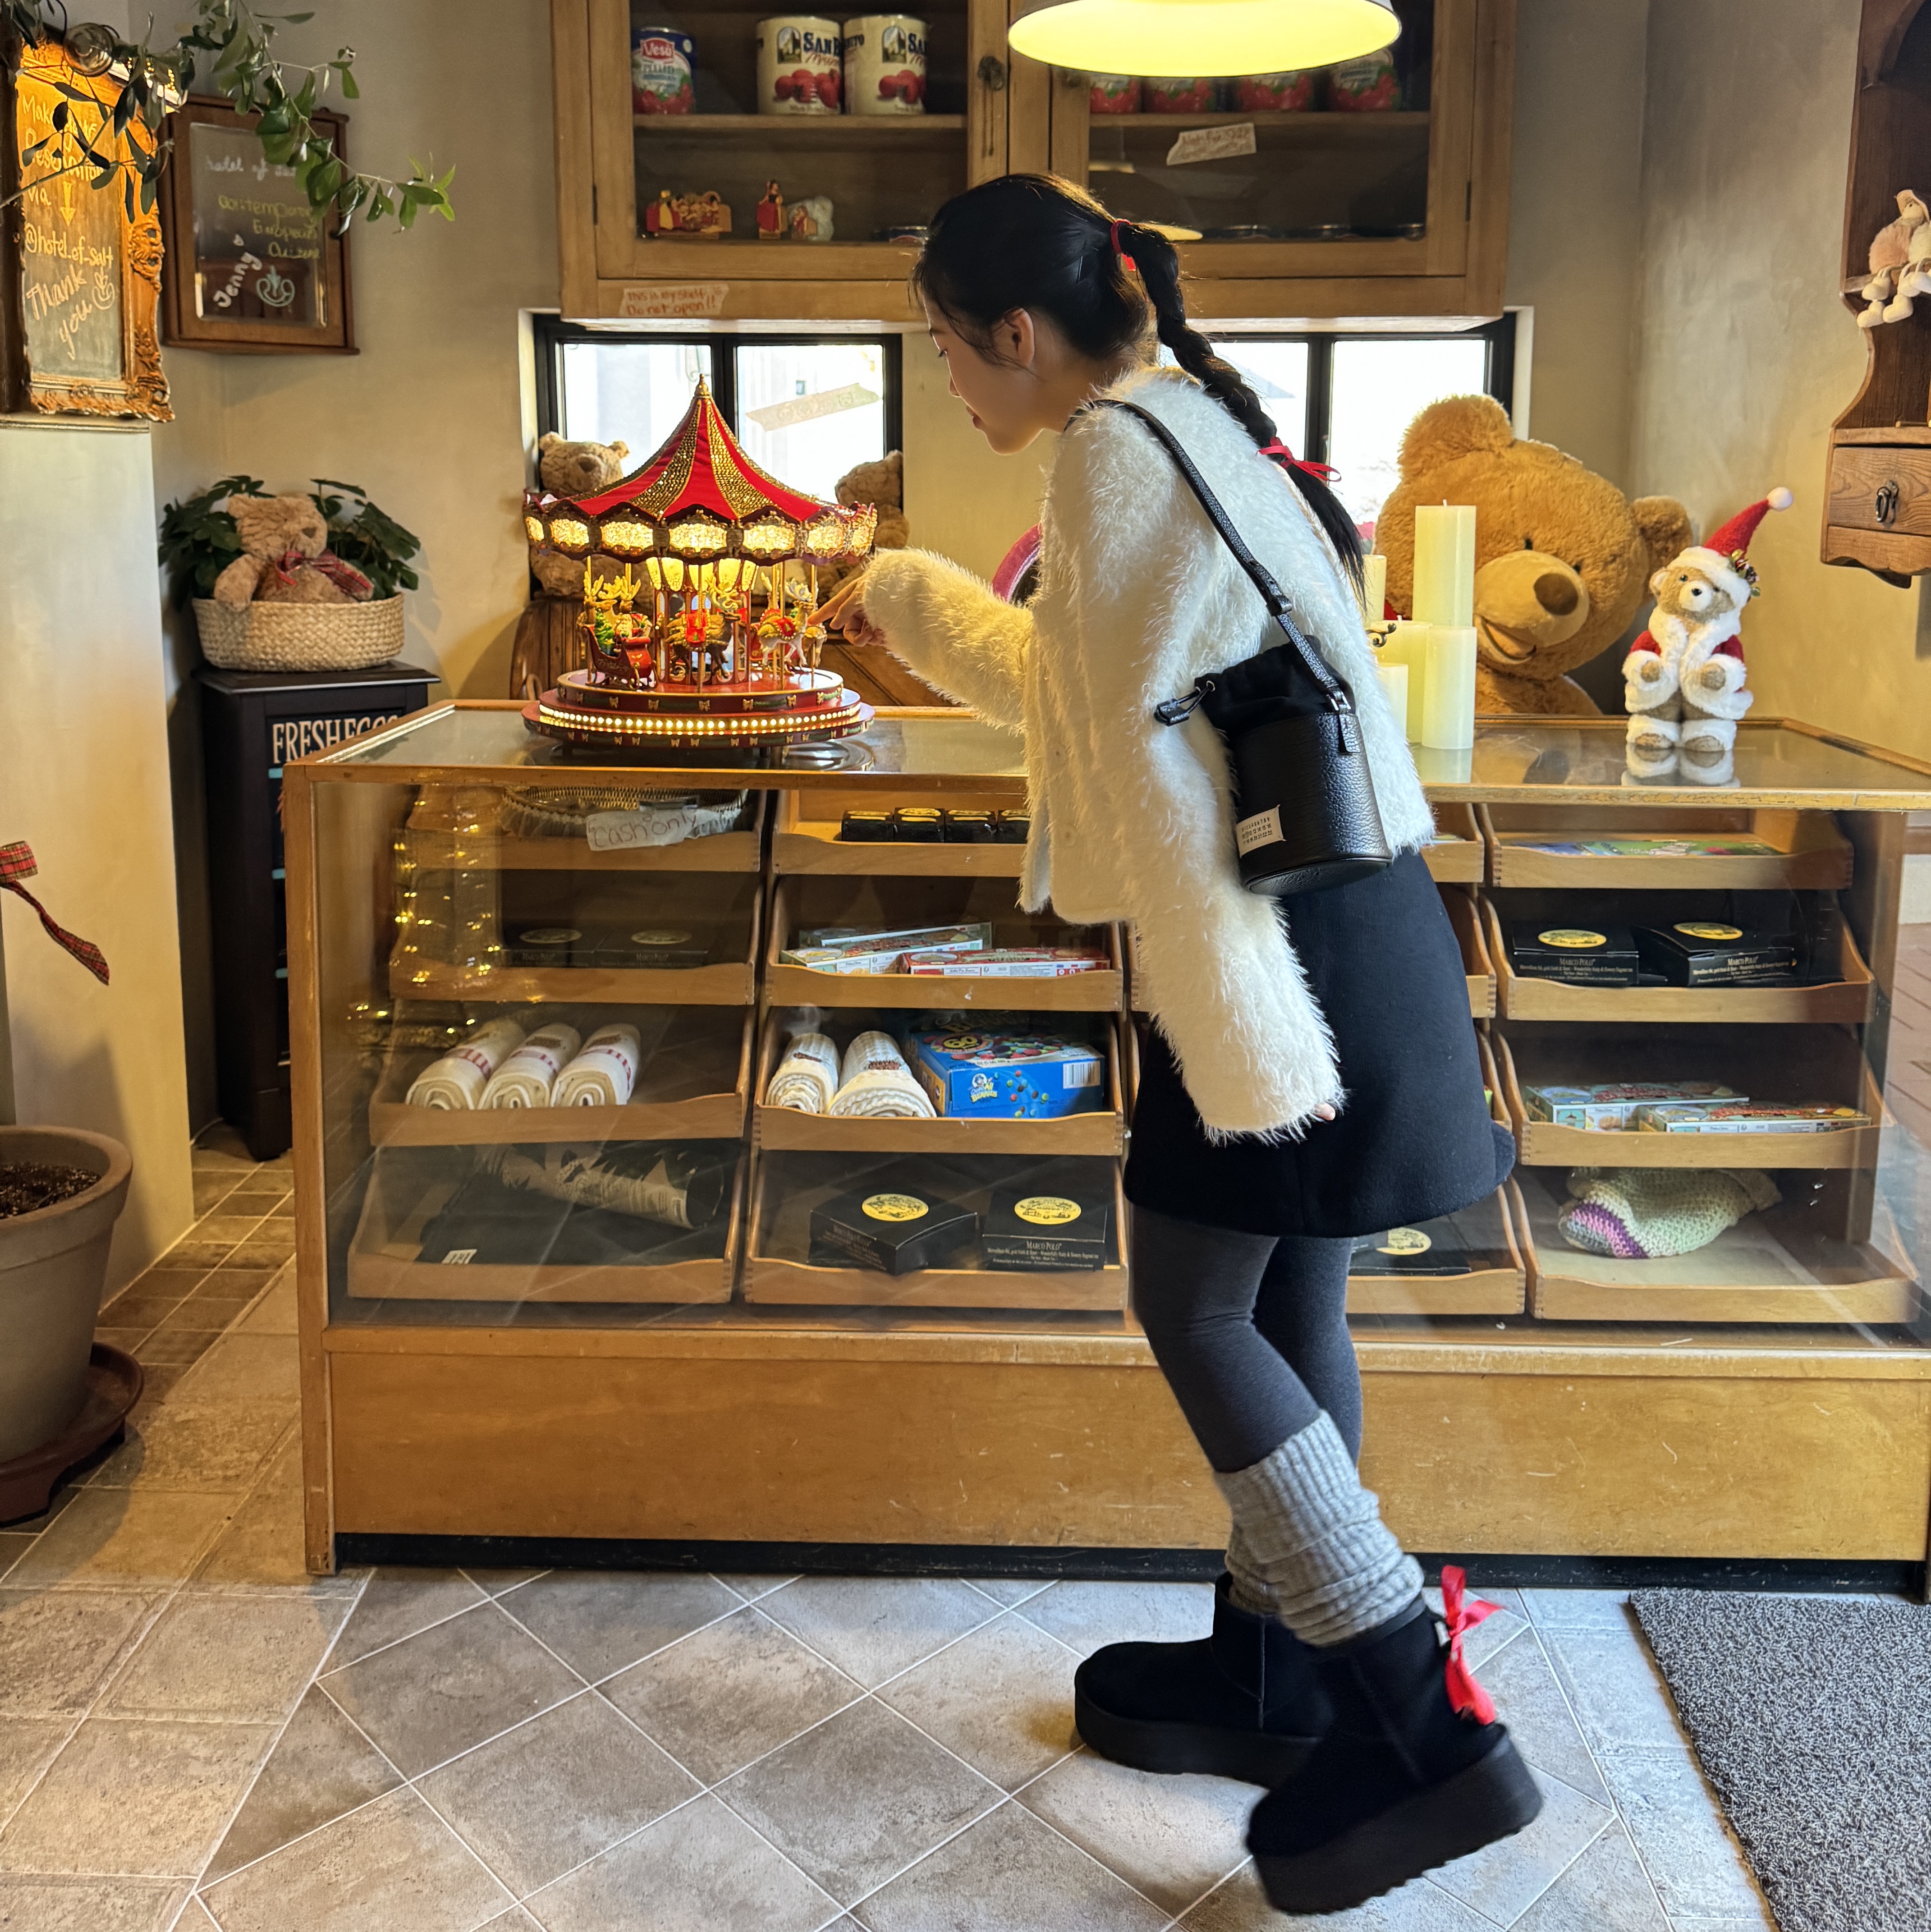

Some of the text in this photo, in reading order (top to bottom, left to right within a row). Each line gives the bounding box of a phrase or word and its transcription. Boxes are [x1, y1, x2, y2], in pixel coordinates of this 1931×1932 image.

[23, 96, 52, 124] Mak
[26, 264, 87, 321] Thank
[213, 252, 262, 307] Jenny
[59, 299, 92, 361] you
[273, 719, 341, 764] FRESH
[652, 811, 696, 835] only
